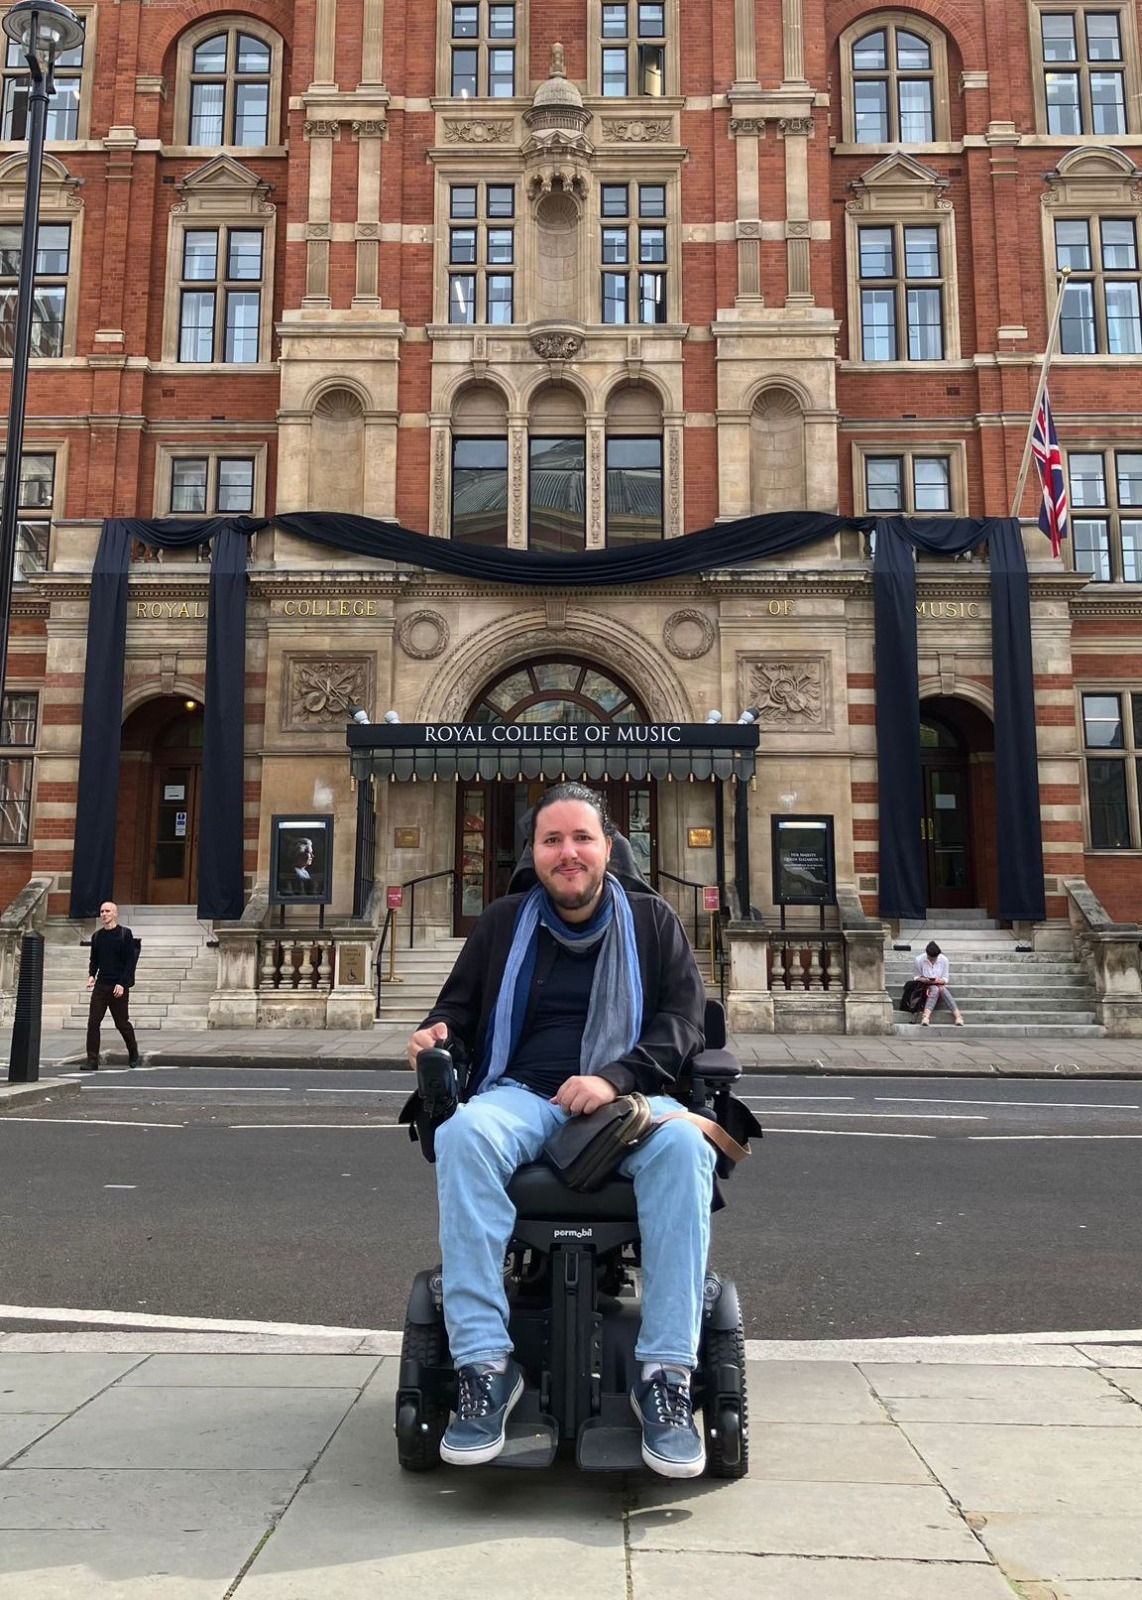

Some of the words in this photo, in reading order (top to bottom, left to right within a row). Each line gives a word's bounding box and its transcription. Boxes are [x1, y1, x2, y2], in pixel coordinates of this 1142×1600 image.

[136, 602, 205, 618] ROYAL
[284, 600, 377, 616] COLLEGE
[768, 599, 795, 615] OF
[425, 726, 486, 741] ROYAL
[492, 725, 578, 741] COLLEGE
[585, 725, 610, 741] OF
[617, 726, 681, 741] MUSIC
[554, 1228, 592, 1238] permobil
